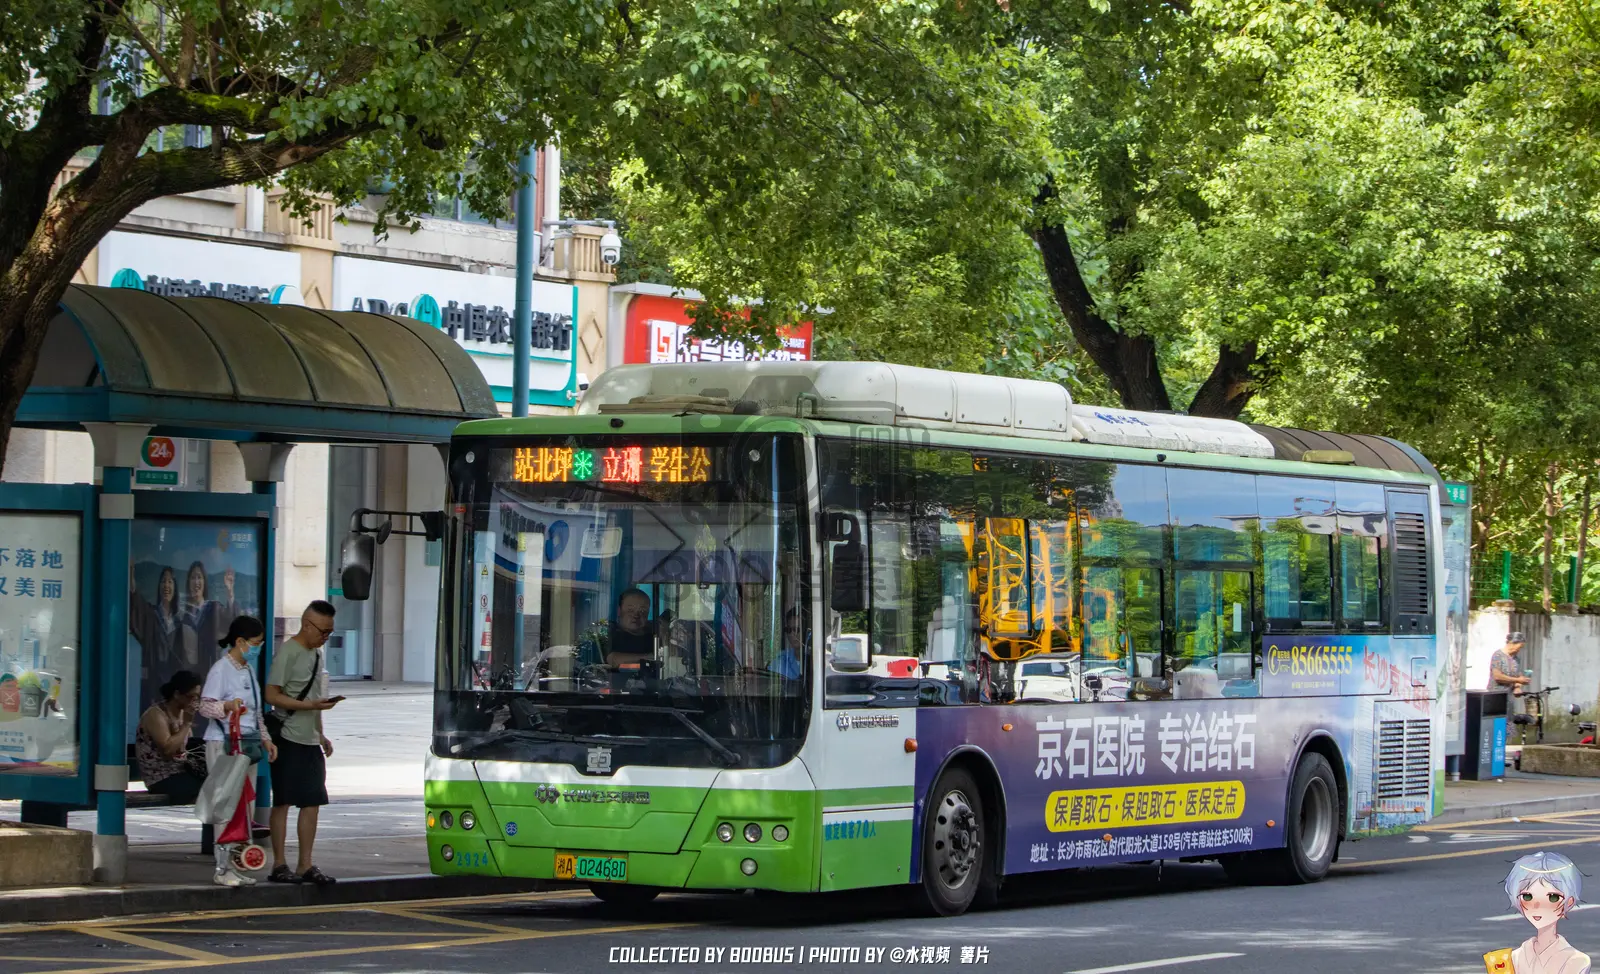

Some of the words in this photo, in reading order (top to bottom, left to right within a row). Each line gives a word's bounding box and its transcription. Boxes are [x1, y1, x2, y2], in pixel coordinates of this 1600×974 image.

[442, 299, 573, 351] 中国农银行
[514, 446, 573, 482] 站北坪
[602, 446, 643, 483] 立珊
[650, 446, 711, 483] 学生公
[1291, 645, 1353, 676] 85665555
[1035, 714, 1146, 779] 京石医院
[1157, 710, 1257, 774] 专治结石
[456, 851, 489, 867] 2924
[556, 857, 573, 876] 湘A
[579, 858, 627, 878] 02468D
